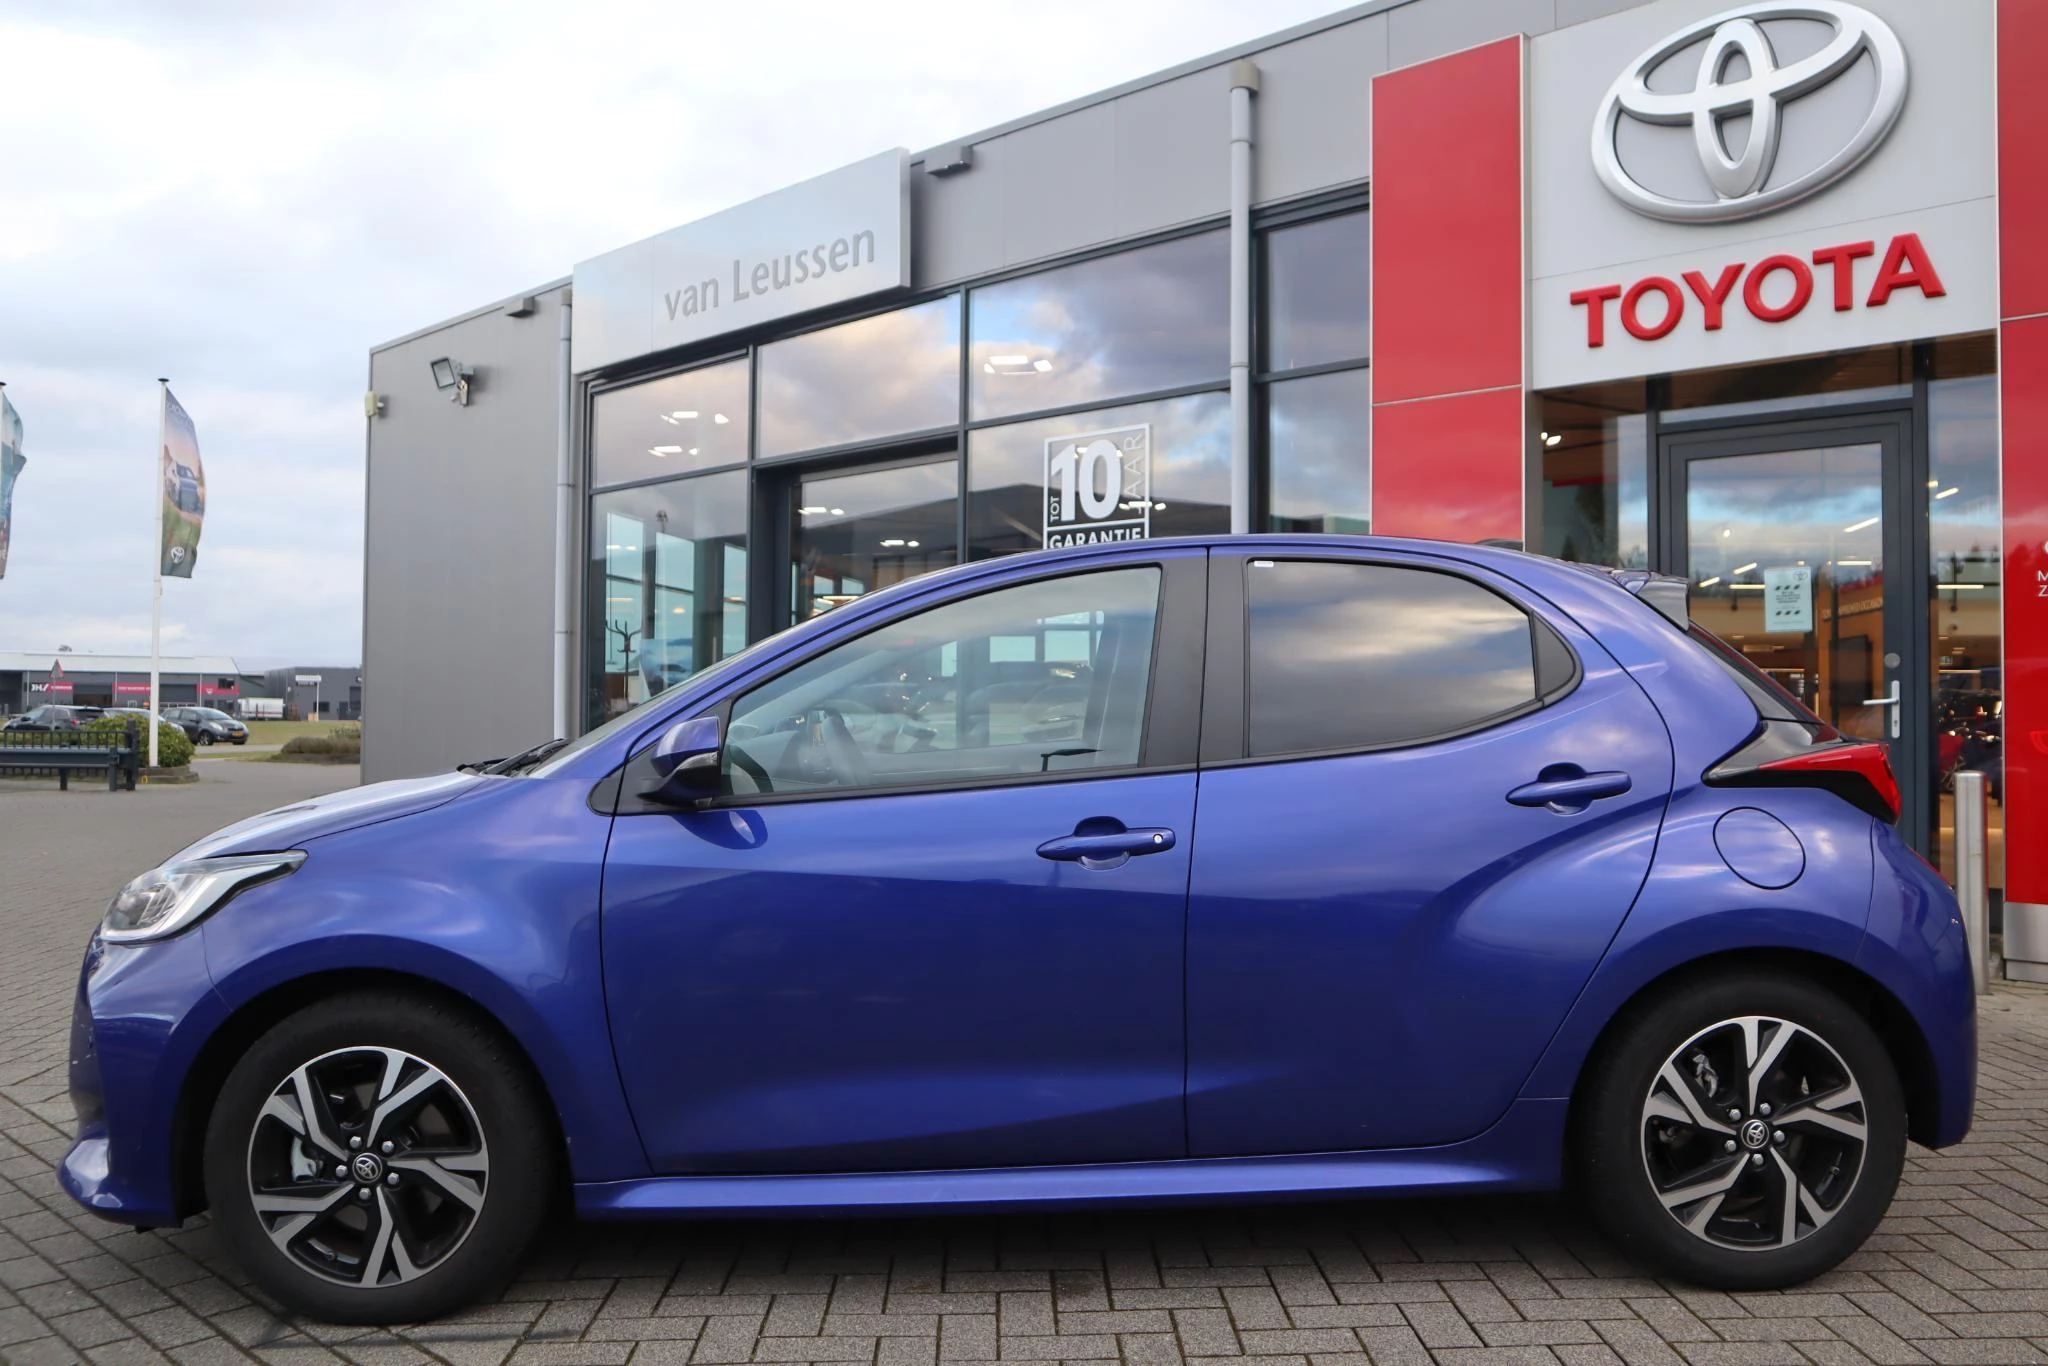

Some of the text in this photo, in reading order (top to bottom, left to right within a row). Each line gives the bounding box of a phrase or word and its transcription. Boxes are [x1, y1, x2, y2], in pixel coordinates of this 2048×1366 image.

[664, 229, 875, 320] van Leussen
[1570, 233, 1946, 348] TOYOTA
[1050, 496, 1060, 522] TOT
[1051, 439, 1122, 521] 10
[1049, 527, 1142, 549] GARANTIE
